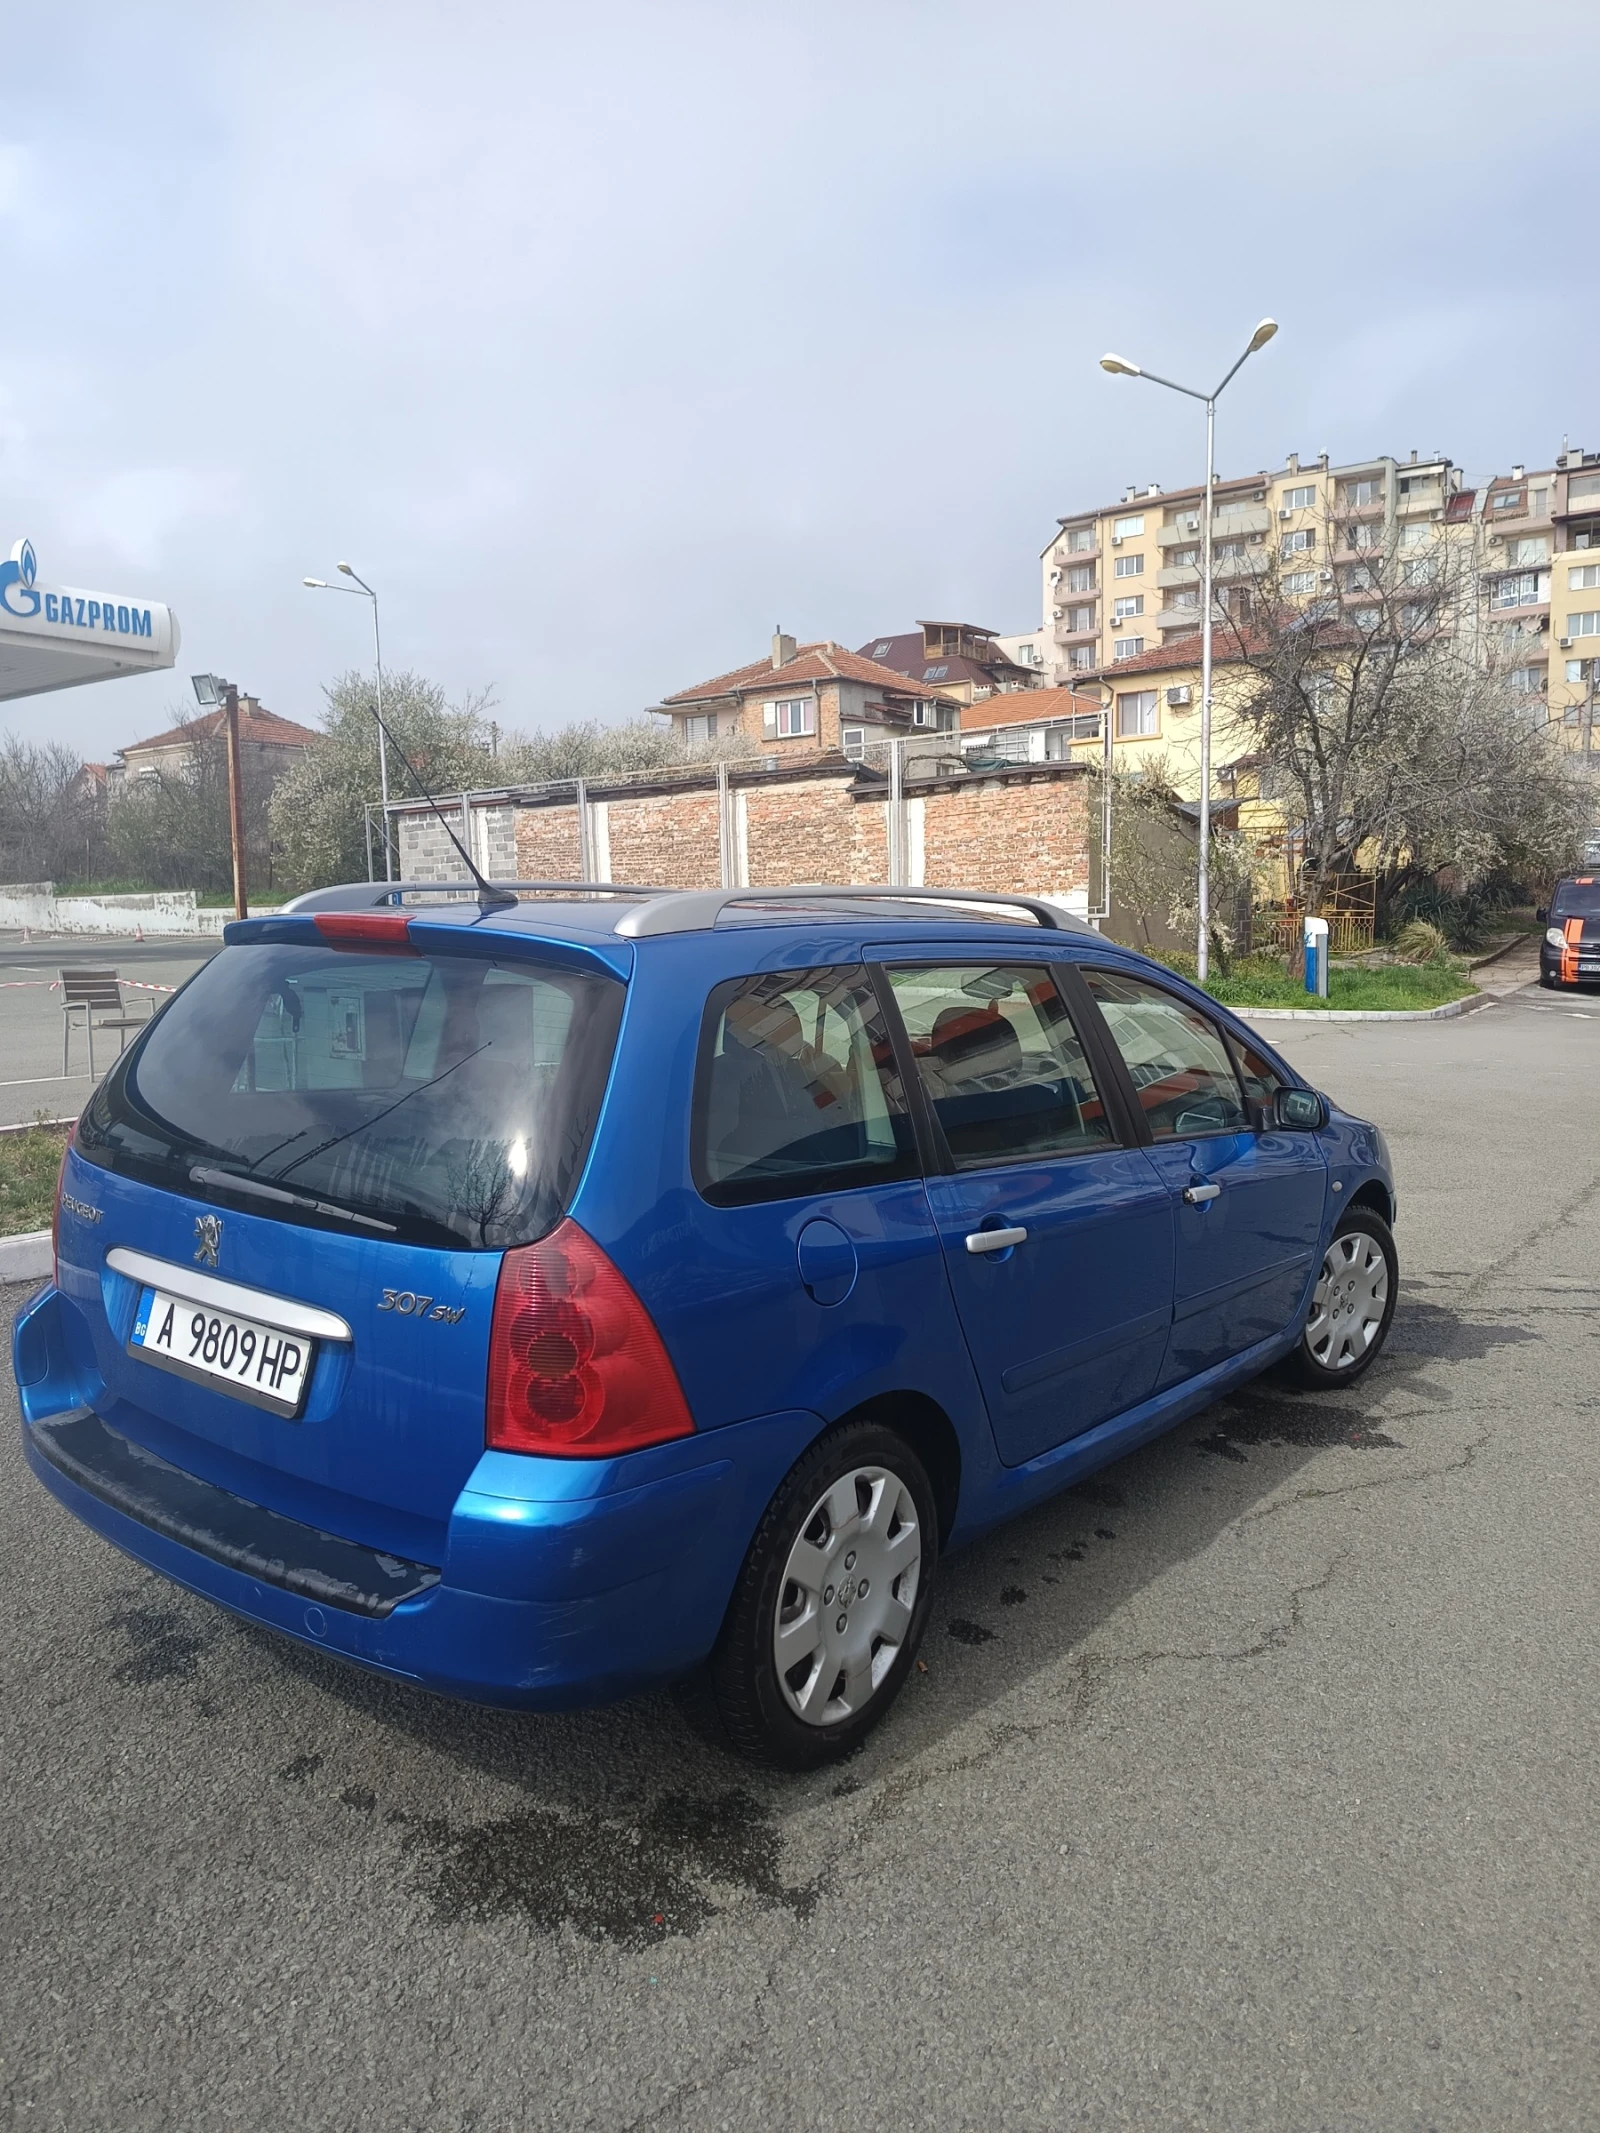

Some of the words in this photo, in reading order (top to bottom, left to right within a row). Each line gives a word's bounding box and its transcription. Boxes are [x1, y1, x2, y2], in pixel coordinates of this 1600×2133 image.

[45, 593, 152, 638] GAZPROM
[63, 1192, 105, 1224] PEUGEOT
[377, 1288, 433, 1317] 307
[429, 1306, 466, 1325] SW
[134, 1322, 147, 1337] BG
[156, 1303, 175, 1348] A
